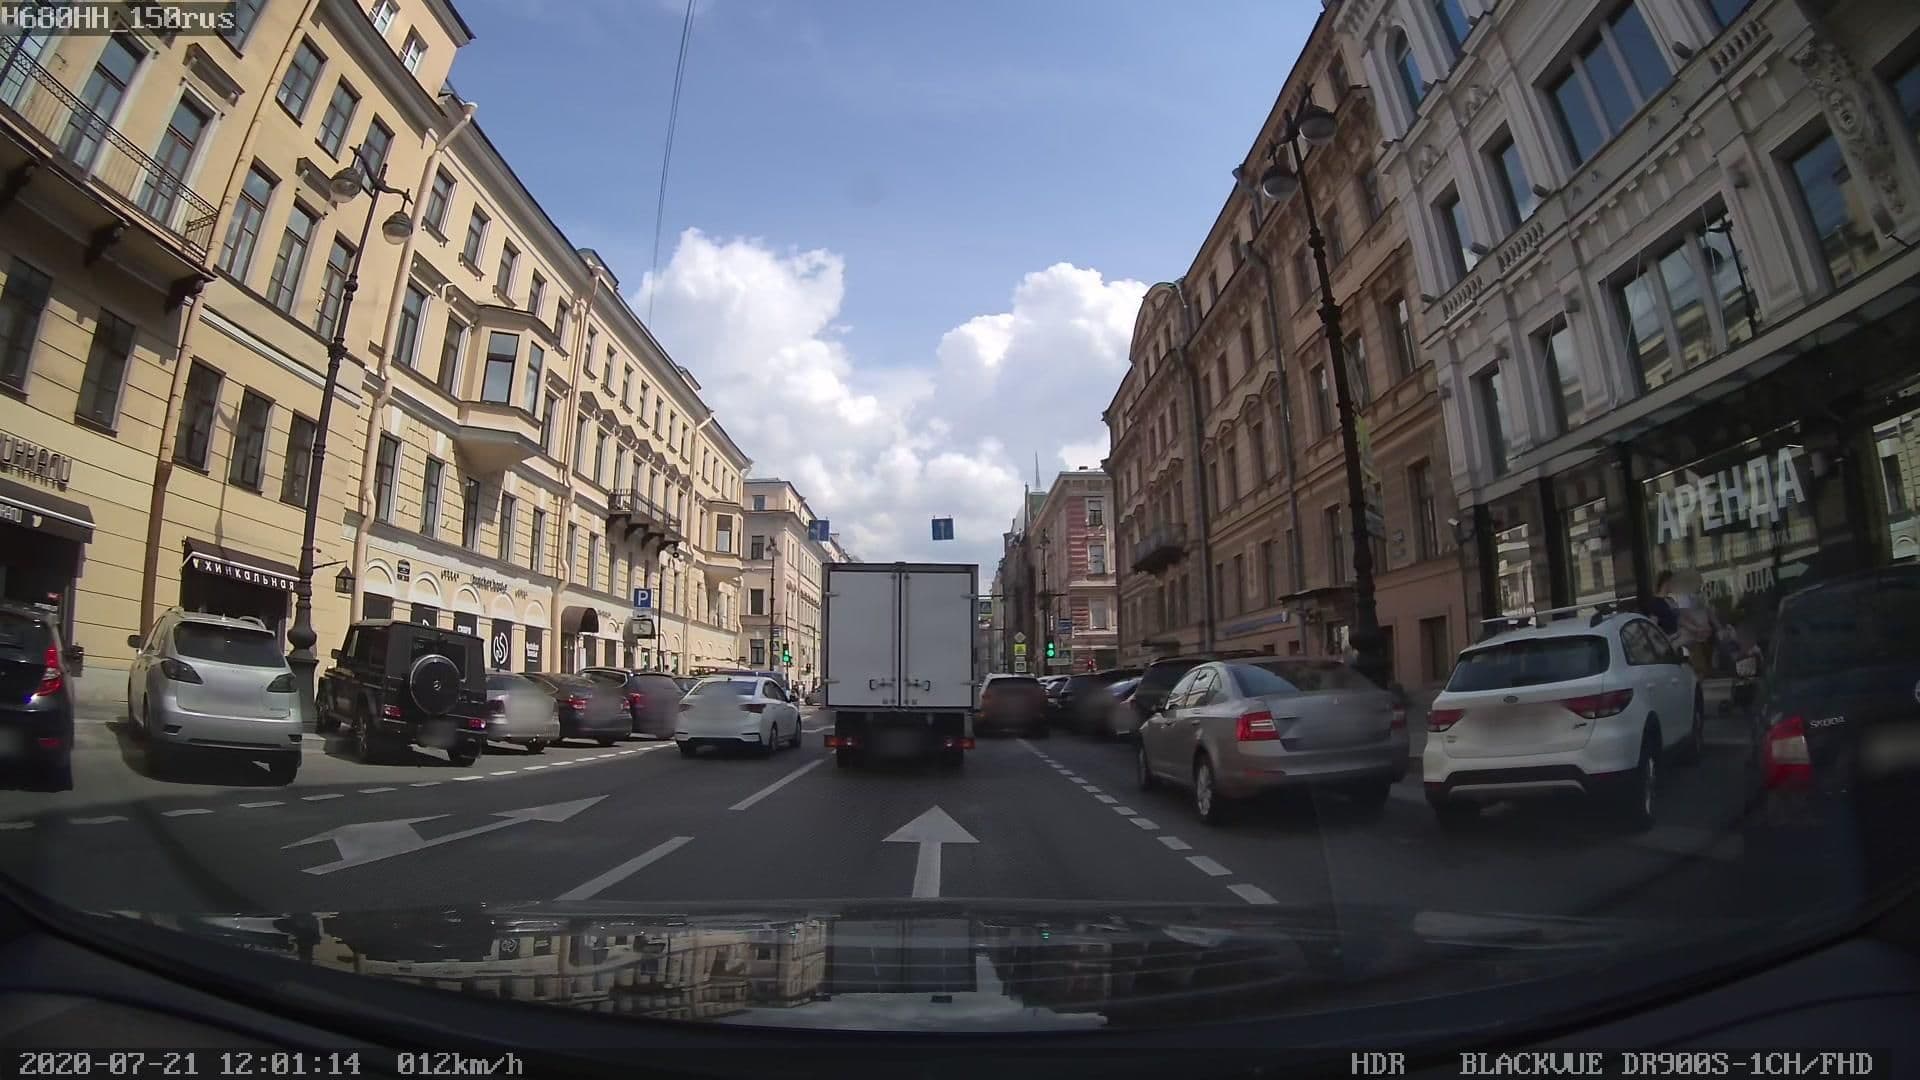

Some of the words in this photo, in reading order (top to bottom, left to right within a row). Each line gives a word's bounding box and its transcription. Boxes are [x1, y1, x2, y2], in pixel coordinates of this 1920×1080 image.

[1656, 447, 1806, 544] АРЕНДА
[205, 560, 295, 591] ХИНКАЛЬНАЯ
[638, 591, 649, 606] P
